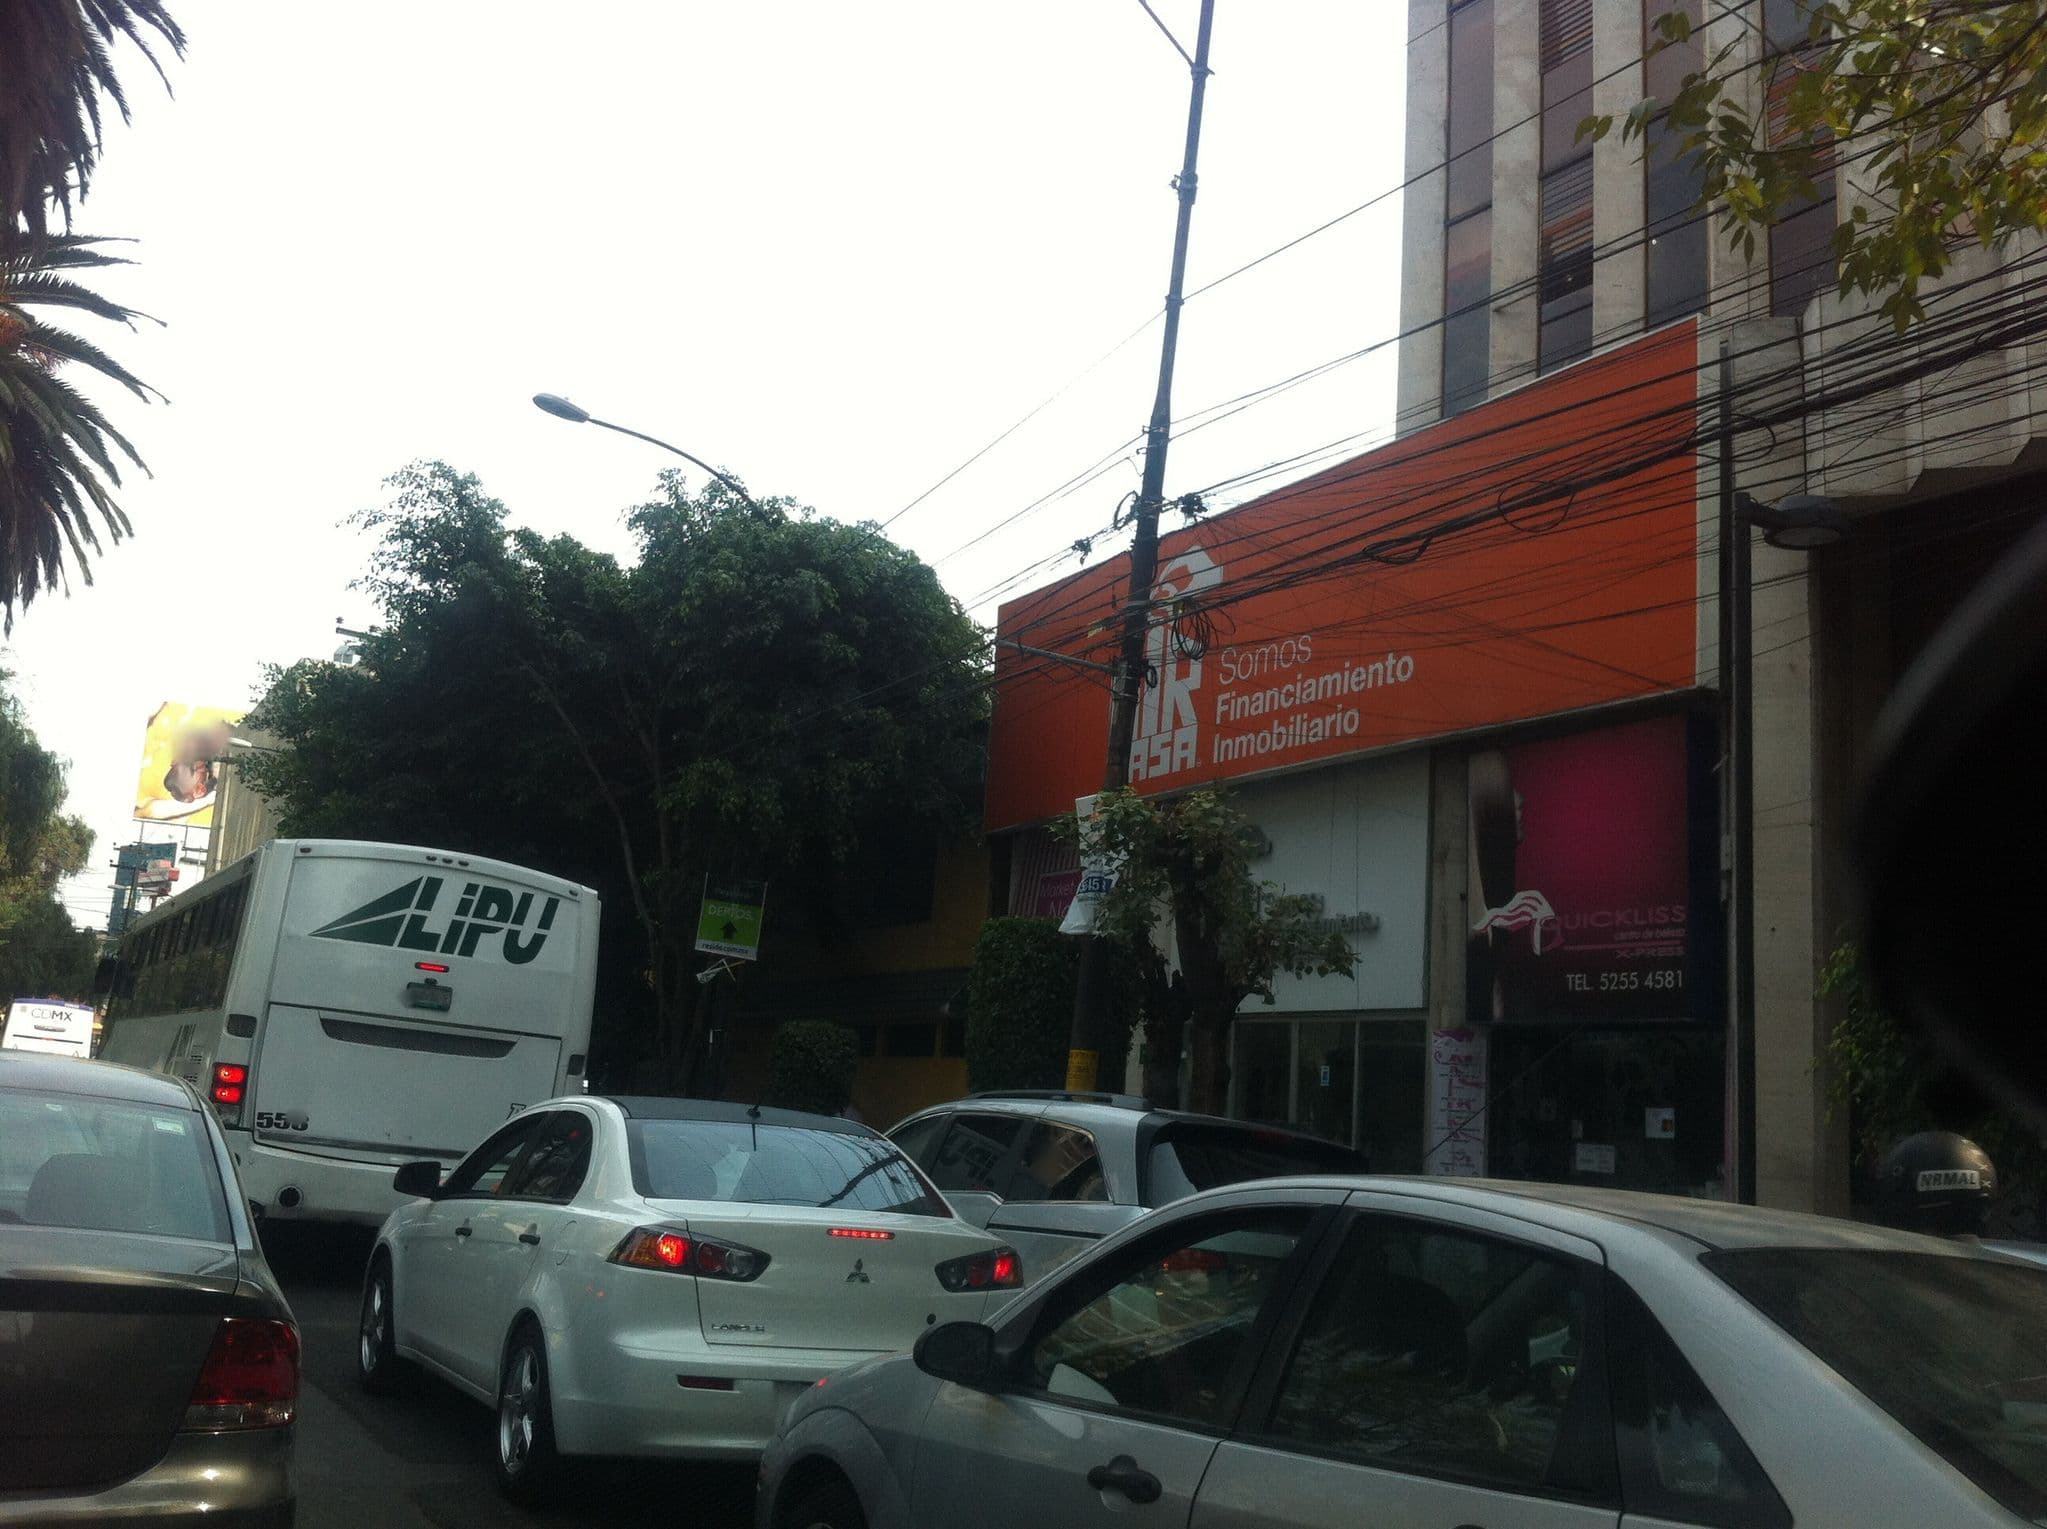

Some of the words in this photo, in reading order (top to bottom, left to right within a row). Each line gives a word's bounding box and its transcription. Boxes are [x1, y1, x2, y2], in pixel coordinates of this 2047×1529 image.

[1219, 634, 1312, 685] Somos
[1215, 652, 1414, 725] Financiamiento
[1126, 723, 1198, 784] ASA
[1213, 703, 1360, 763] Inmobiliario
[1566, 973, 1595, 991] TEL.
[1600, 971, 1639, 990] 5255
[1644, 970, 1683, 989] 4581
[31, 1007, 72, 1022] CDMX
